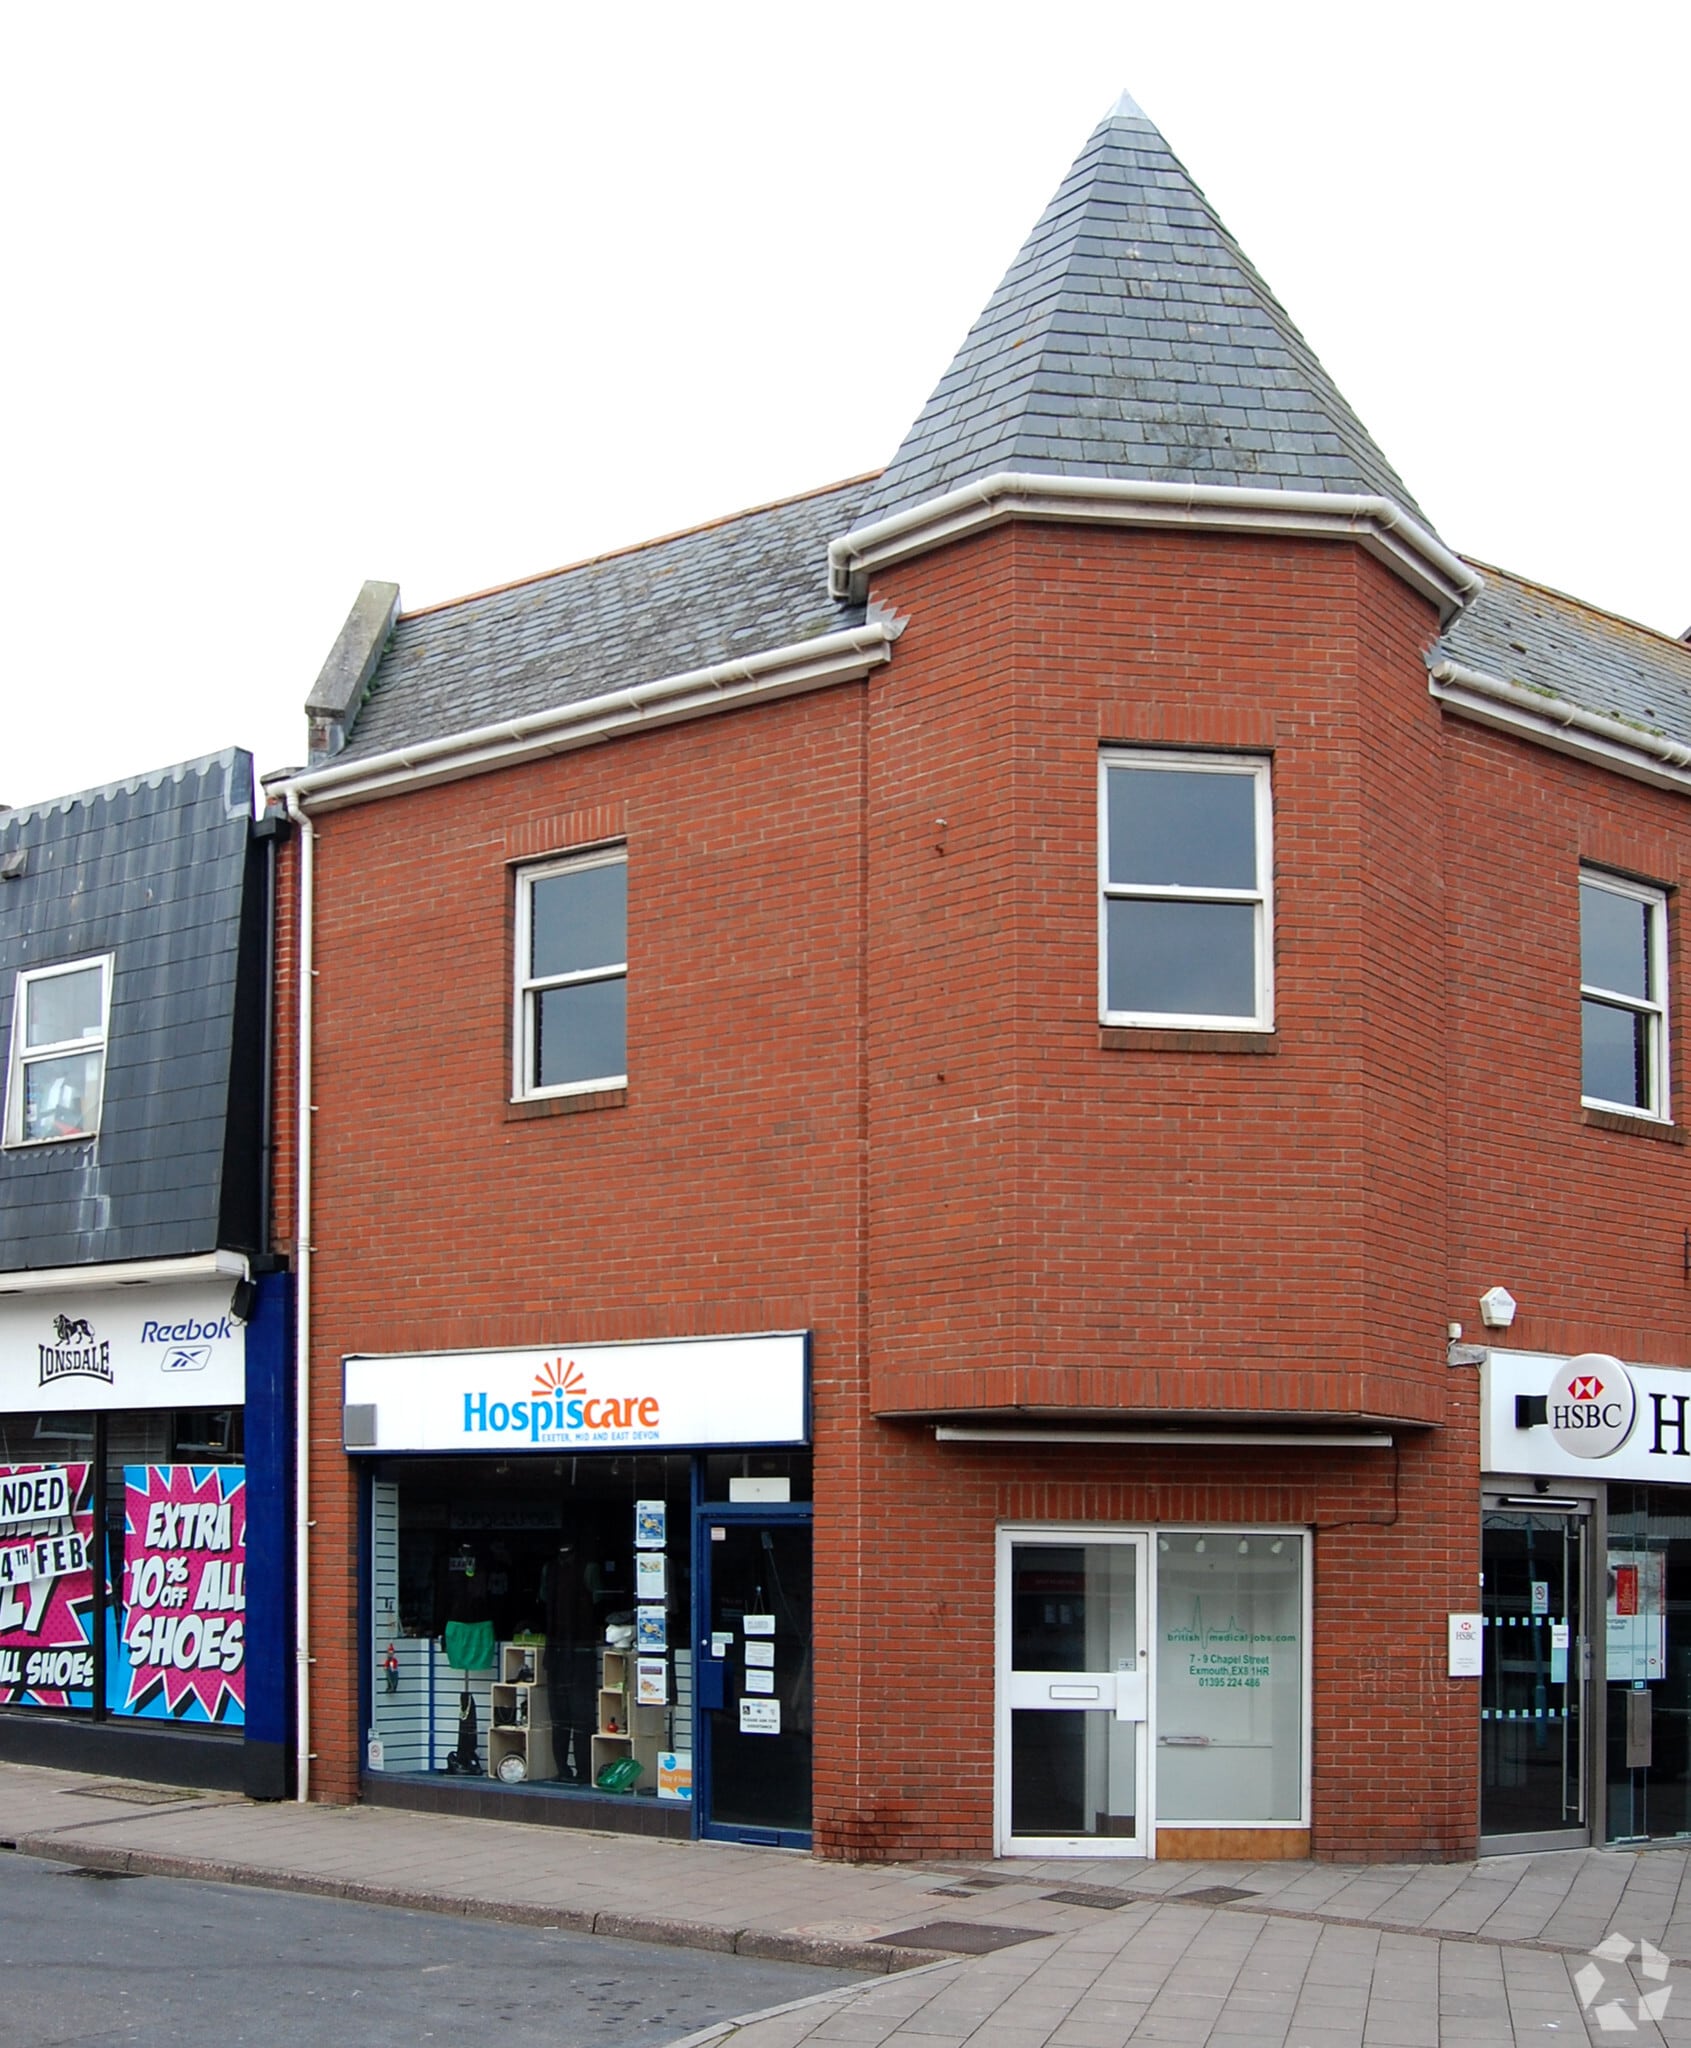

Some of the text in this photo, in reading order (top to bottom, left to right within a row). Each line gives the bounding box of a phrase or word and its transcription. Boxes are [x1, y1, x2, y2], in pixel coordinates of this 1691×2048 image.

[141, 1317, 232, 1343] Reebok
[38, 1341, 113, 1384] LONSDALE
[463, 1388, 660, 1442] Hospiscare
[1553, 1403, 1622, 1429] HSBC
[575, 1432, 590, 1441] MID
[593, 1432, 608, 1441] AND
[611, 1431, 629, 1440] EAST
[632, 1430, 659, 1440] DEVON
[0, 1477, 64, 1516] NDED
[145, 1501, 232, 1551] EXTRA
[36, 1537, 84, 1576] FEB
[160, 1585, 188, 1607] OFF
[193, 1560, 246, 1612] ALL
[129, 1614, 244, 1673] SHOES
[1456, 1631, 1477, 1641] HSBC
[1190, 1654, 1196, 1663] 7
[1210, 1654, 1241, 1665] Chapel
[1243, 1655, 1269, 1664] Street
[1251, 1667, 1269, 1676] 1HR
[1199, 1677, 1225, 1687] 01395
[1227, 1678, 1242, 1687] 224
